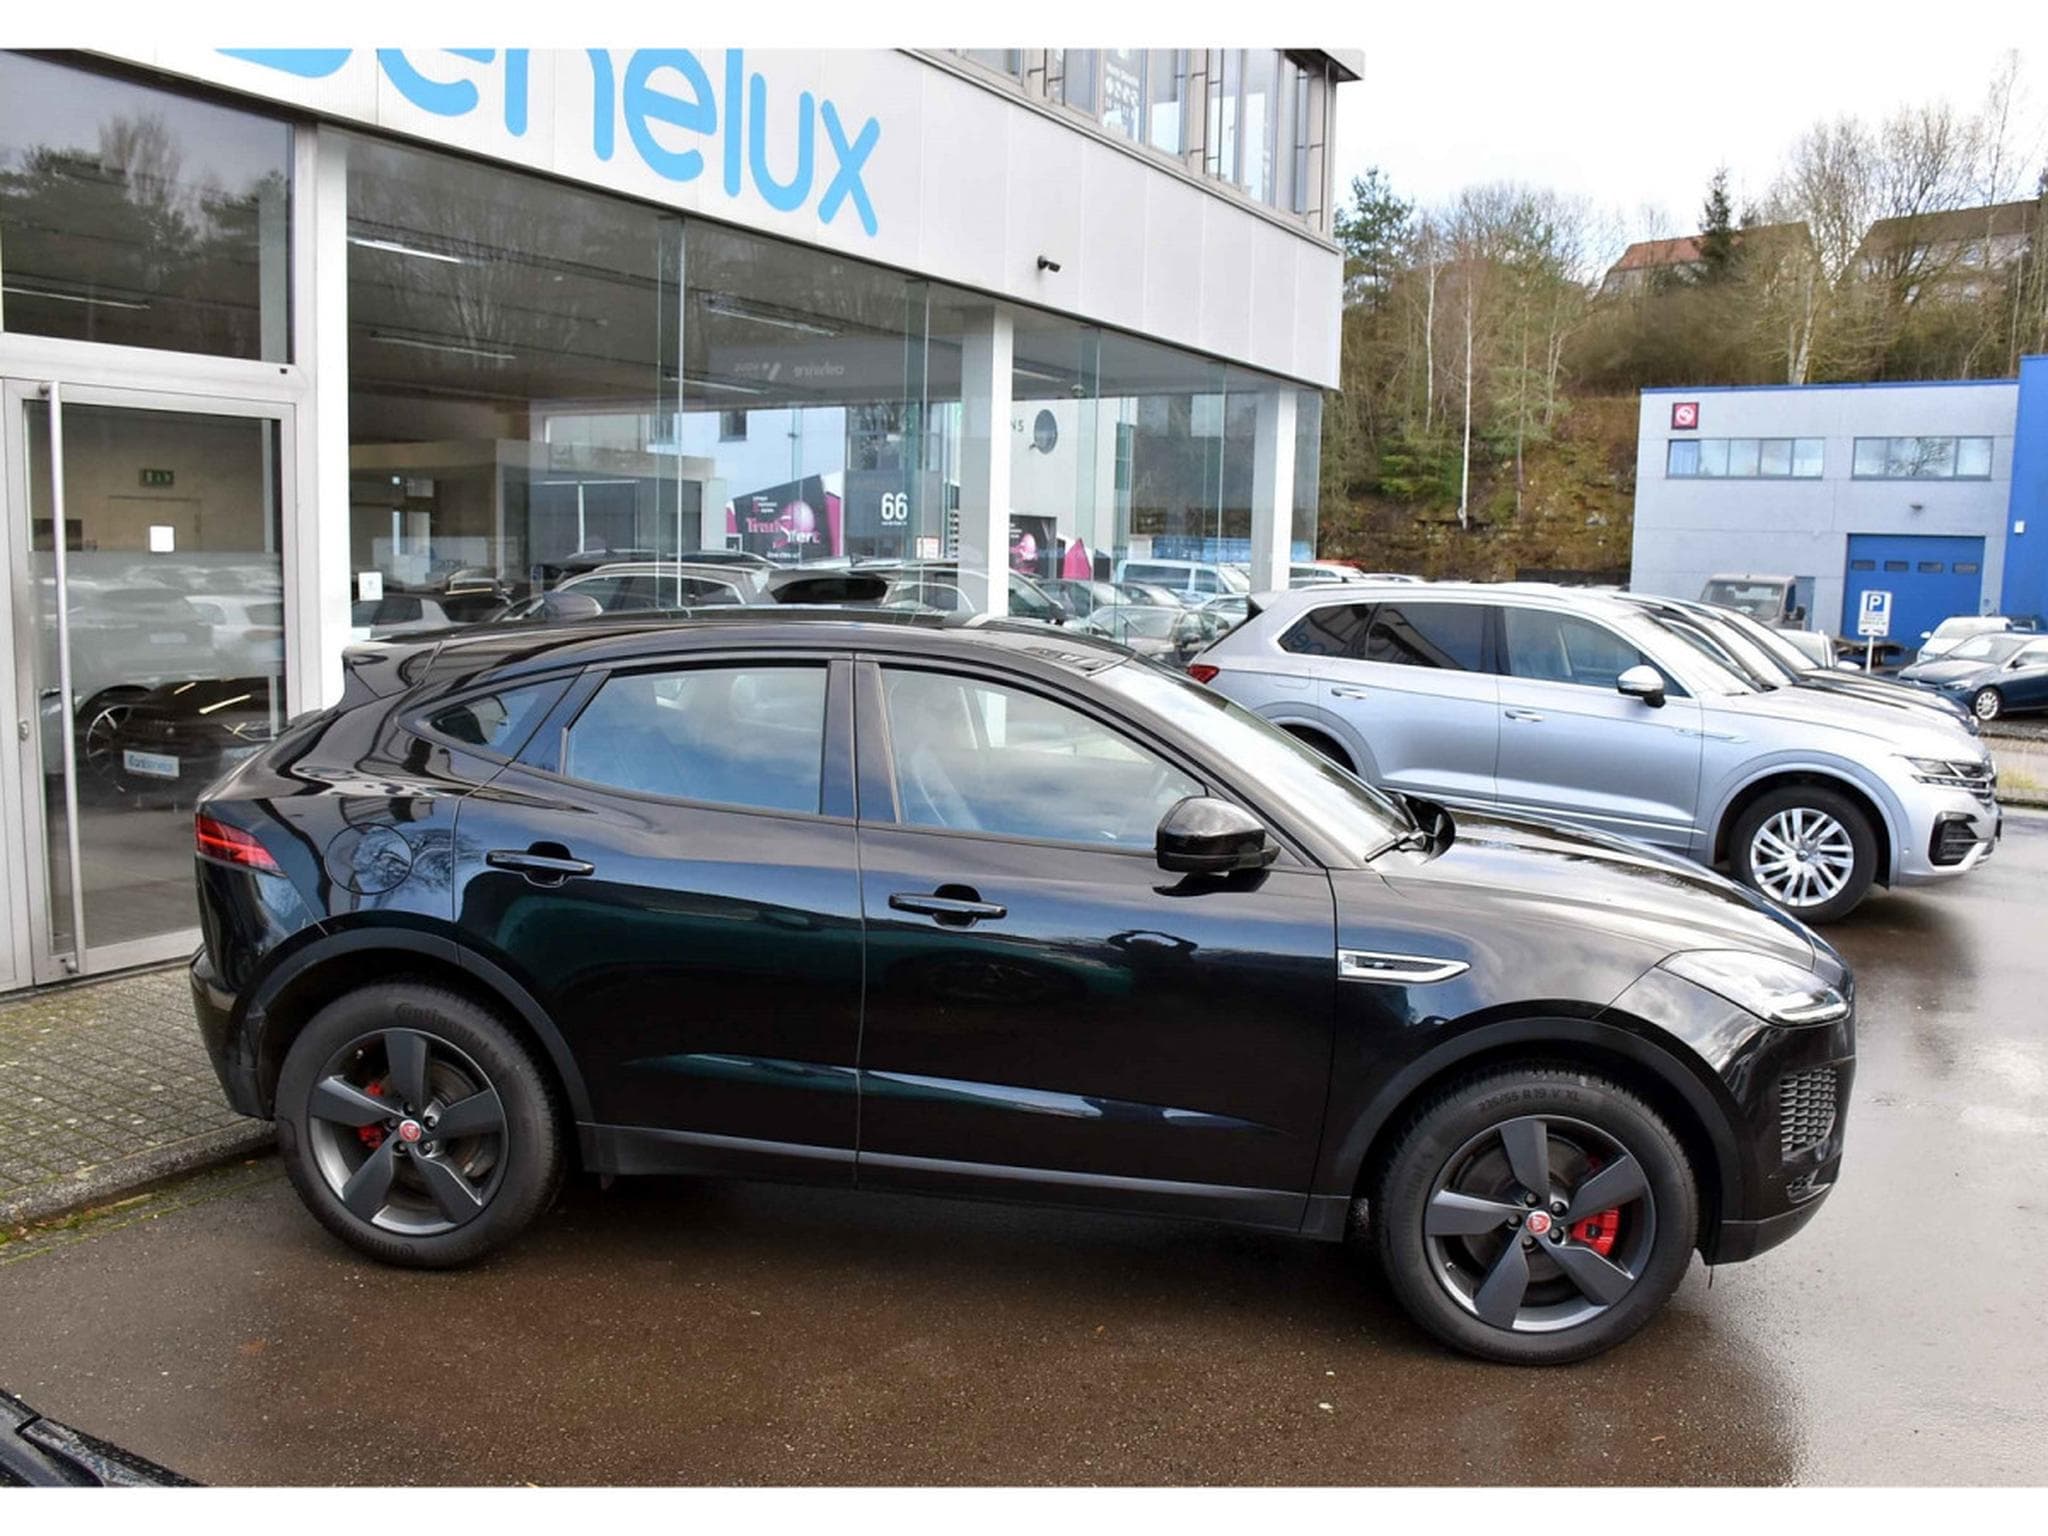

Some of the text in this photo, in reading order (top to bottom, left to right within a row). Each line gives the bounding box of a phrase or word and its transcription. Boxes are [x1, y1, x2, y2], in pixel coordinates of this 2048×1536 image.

[213, 48, 881, 237] nelux
[881, 492, 907, 521] 66
[1869, 595, 1882, 610] P
